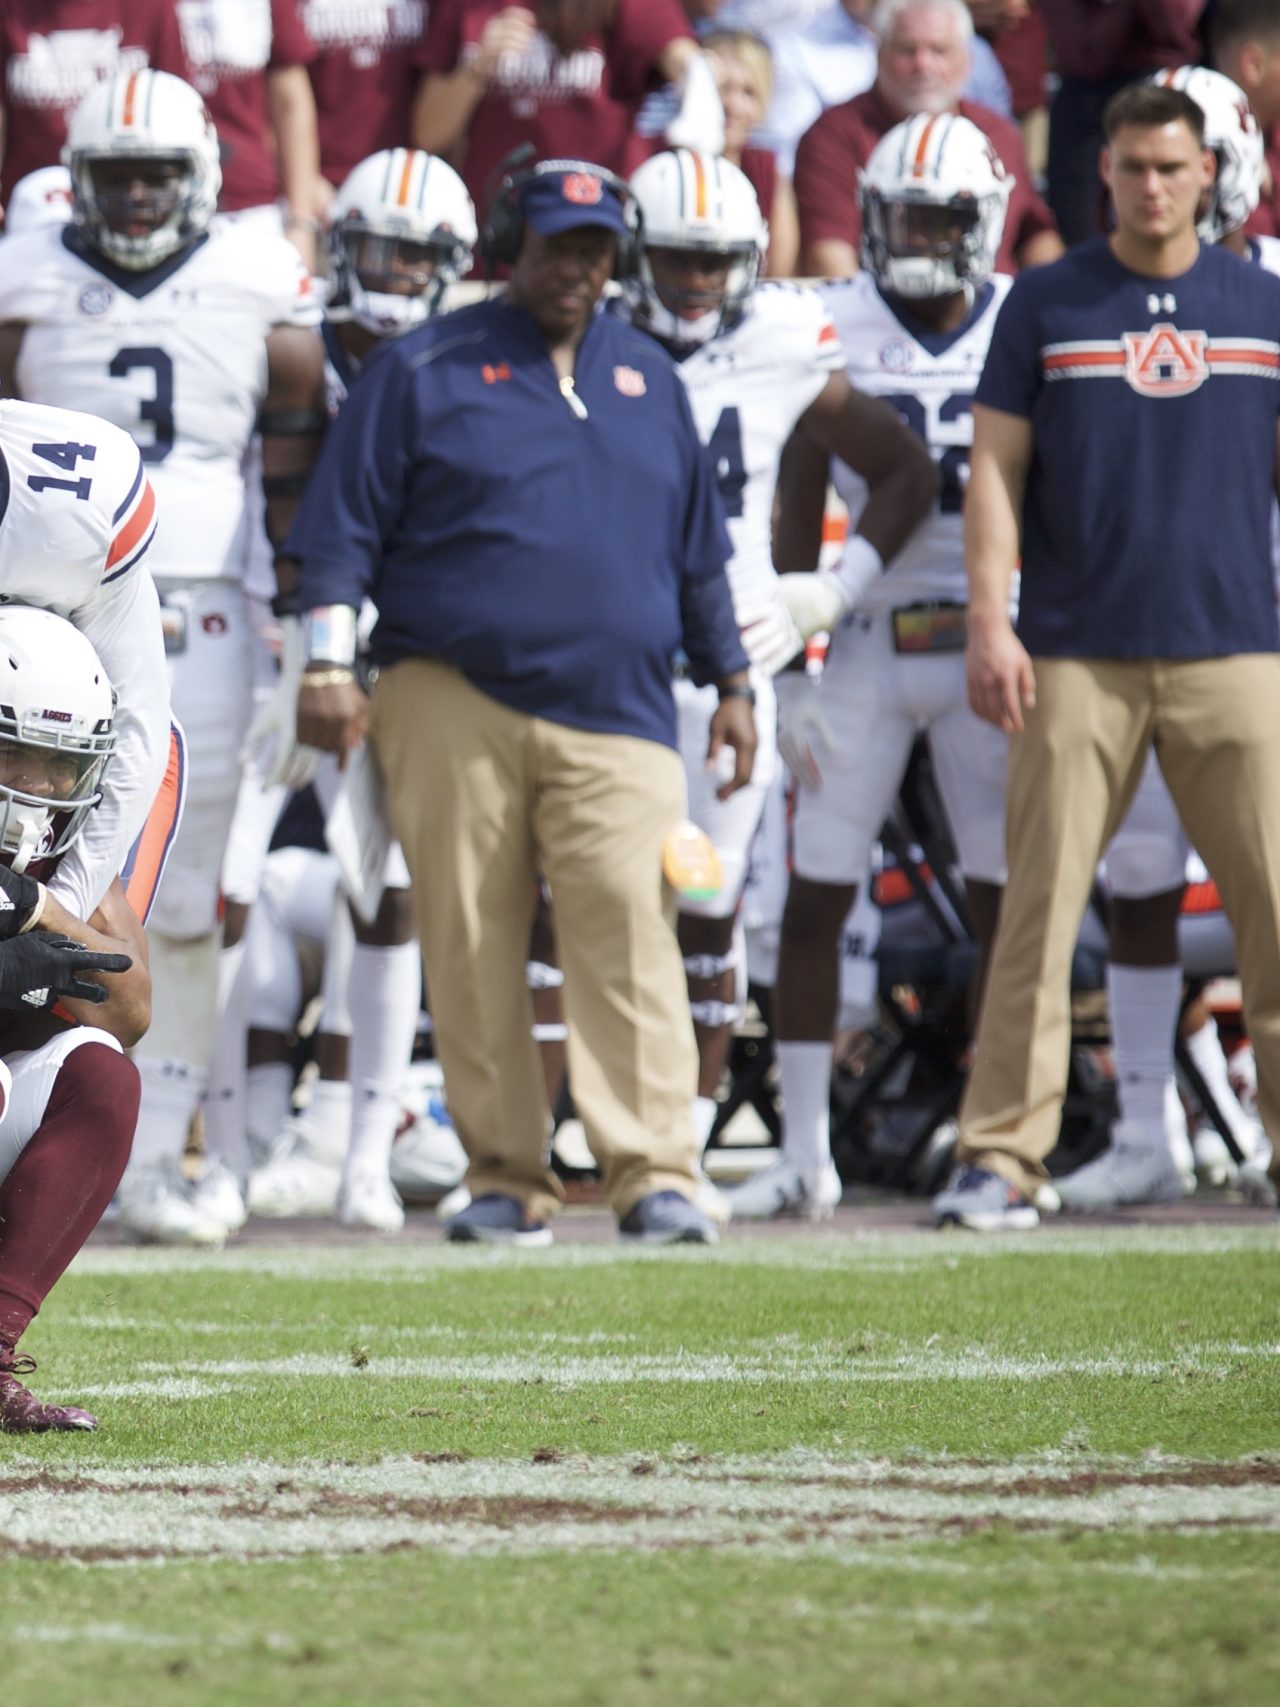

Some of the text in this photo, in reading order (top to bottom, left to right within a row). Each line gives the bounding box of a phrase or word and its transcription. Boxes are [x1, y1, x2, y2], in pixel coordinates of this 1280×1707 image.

[109, 346, 175, 463] 3
[27, 441, 97, 501] 14
[41, 709, 73, 723] AGGIES
